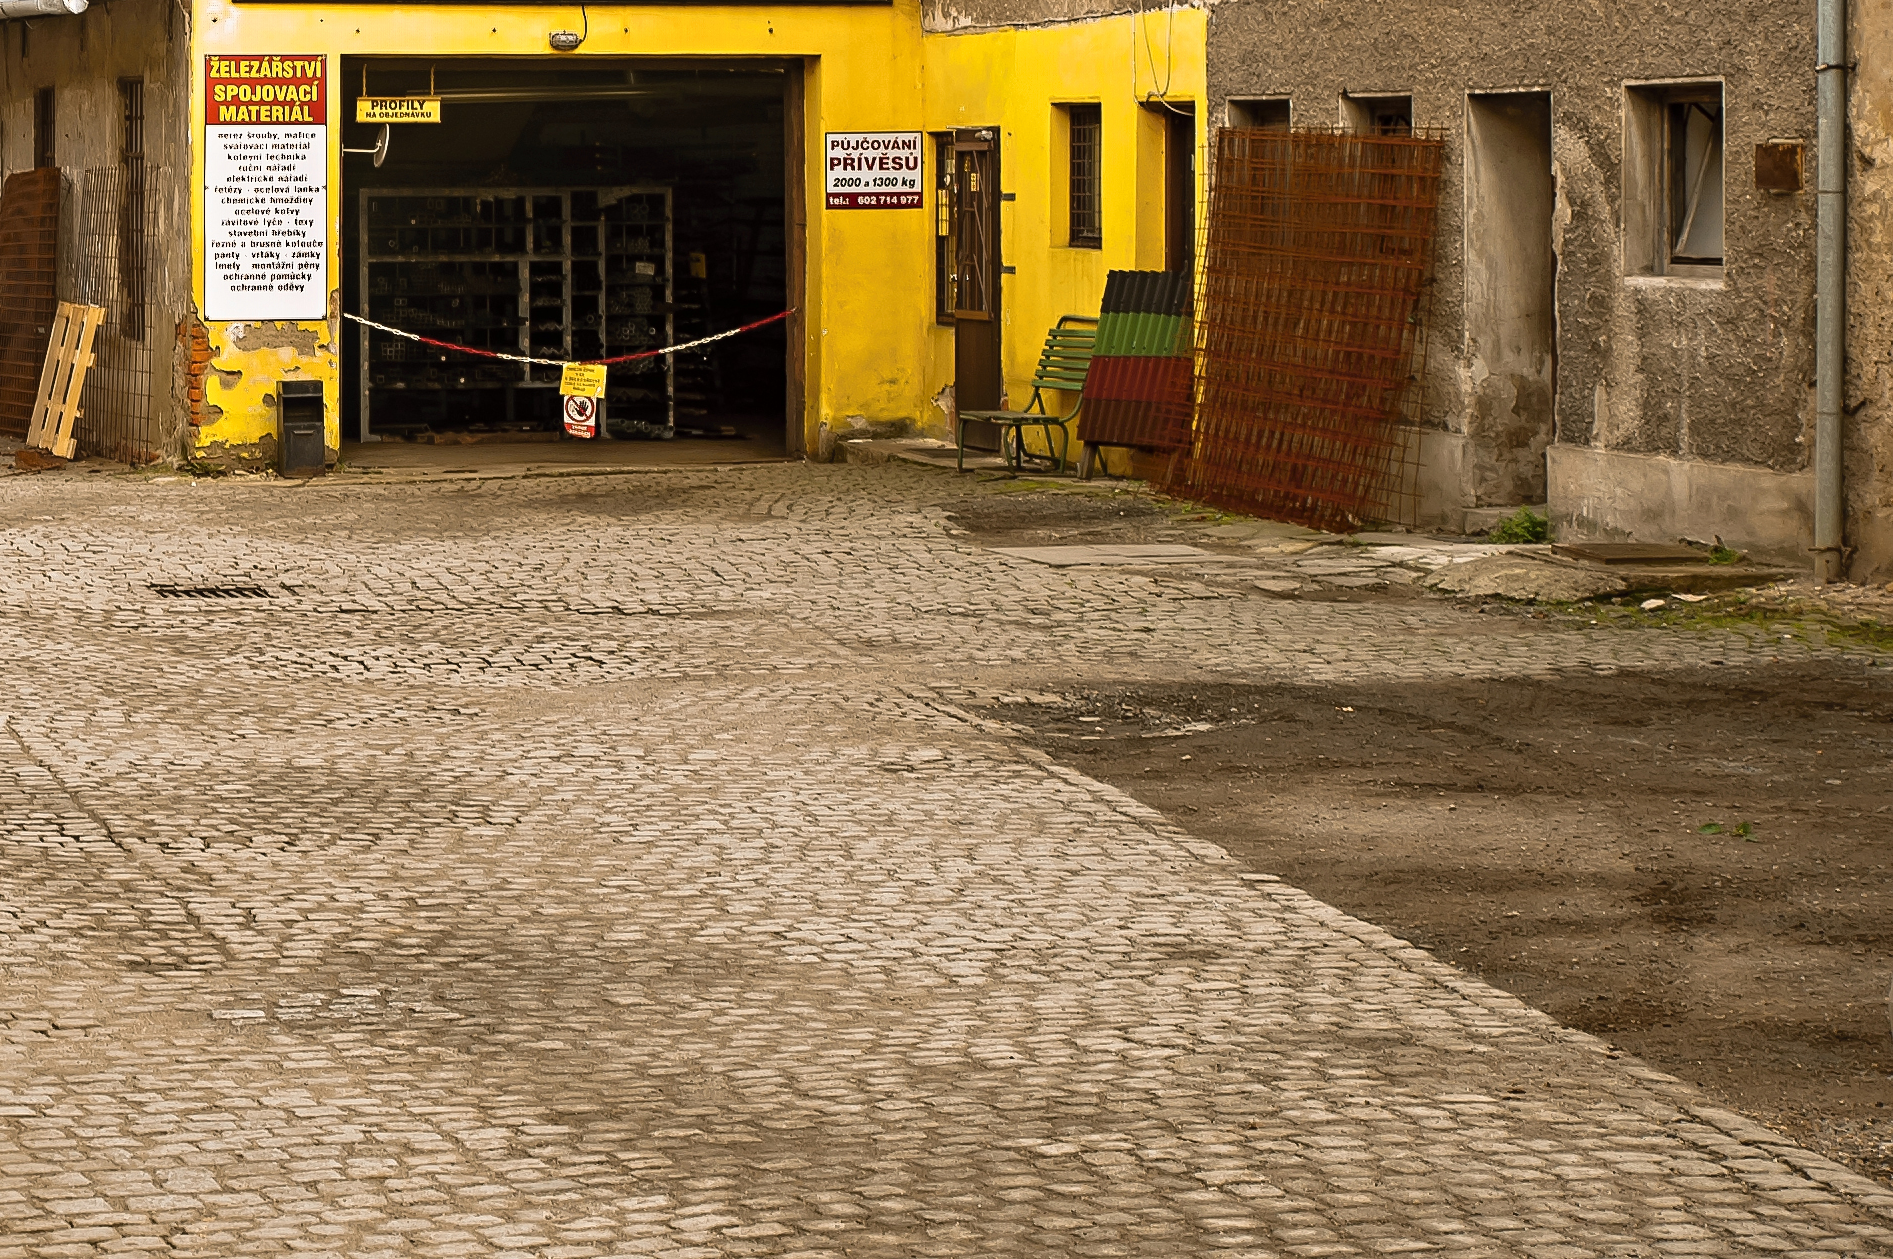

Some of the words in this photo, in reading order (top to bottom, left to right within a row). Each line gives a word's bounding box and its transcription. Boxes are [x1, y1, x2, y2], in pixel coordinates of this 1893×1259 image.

[209, 55, 323, 78] ŽELEZÁŘSTVÍ
[213, 80, 320, 102] SPOJOVACÍ
[219, 101, 314, 122] MATERIÁL
[370, 99, 427, 111] PROFILY
[365, 111, 377, 119] NA
[830, 136, 918, 151] PŮJČOVÁNÍ
[829, 152, 919, 172] PŘÍVĚSŮ
[832, 177, 862, 188] 2000
[872, 176, 899, 188] 1300
[900, 176, 916, 190] kg
[857, 195, 878, 206] 602
[879, 195, 898, 206] 714
[899, 195, 920, 206] 977
